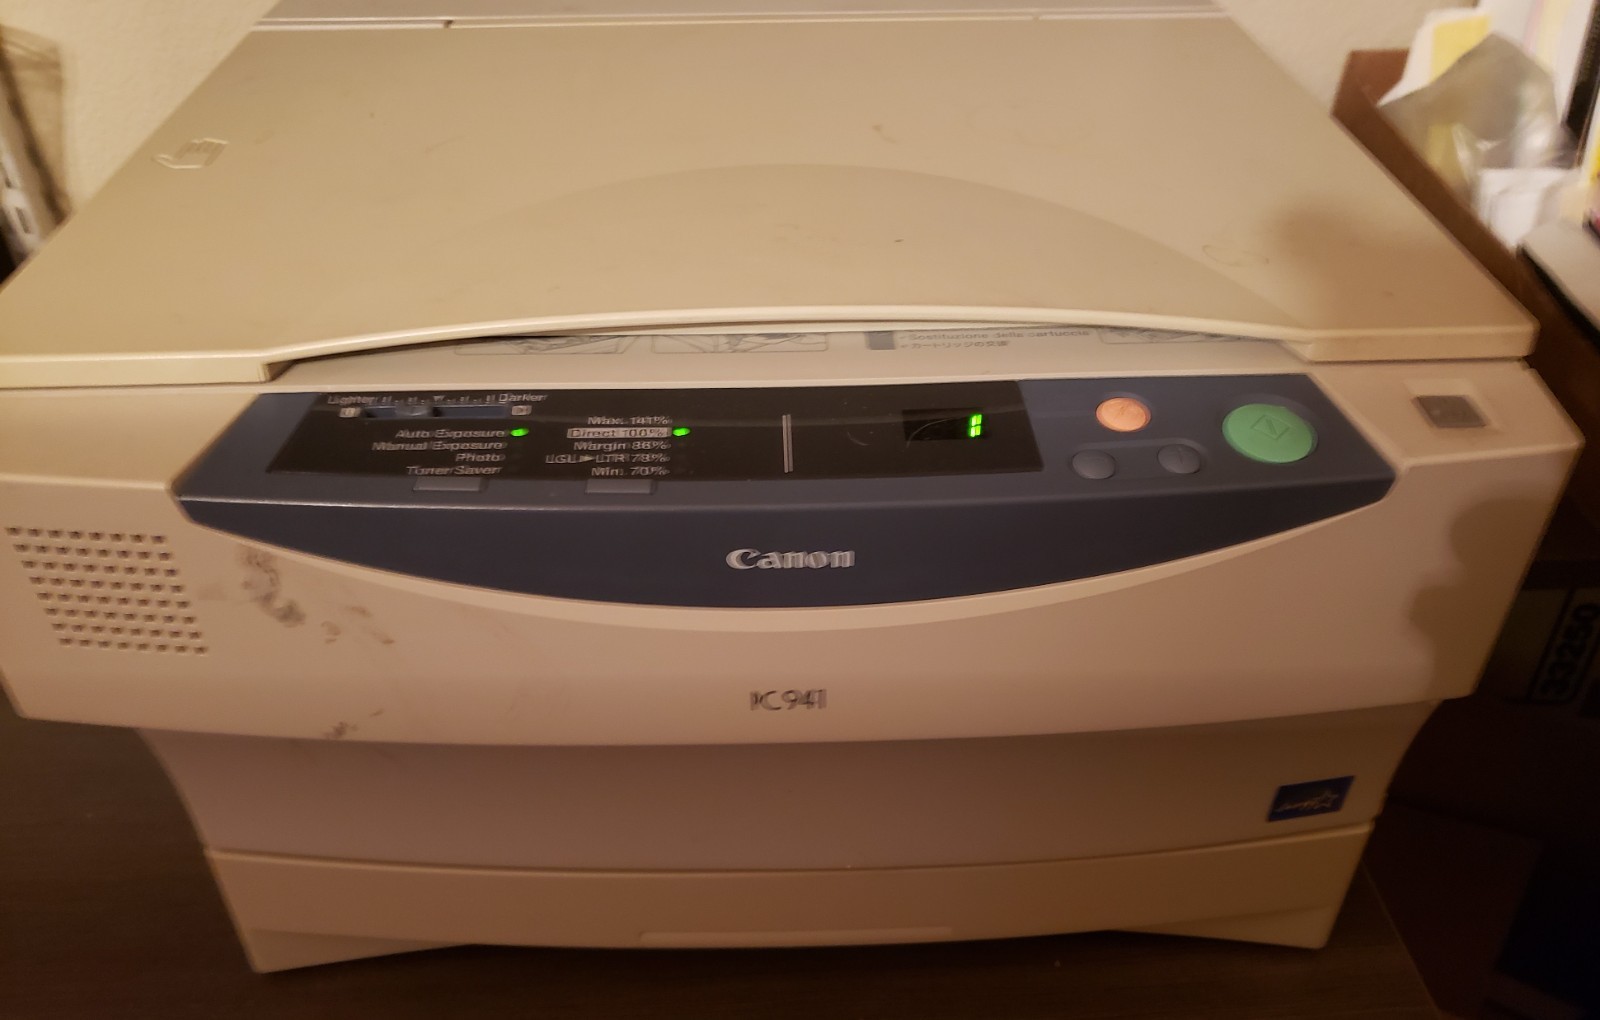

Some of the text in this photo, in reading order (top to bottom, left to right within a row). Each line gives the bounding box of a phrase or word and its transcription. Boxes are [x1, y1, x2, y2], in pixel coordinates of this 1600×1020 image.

[499, 393, 547, 403] Darker
[395, 429, 507, 441] Auto Exposure
[571, 428, 667, 438] Direct 100%
[371, 441, 506, 452] Manual Exposure
[573, 441, 626, 452] Margin
[455, 453, 505, 463] Photo
[631, 453, 670, 463] 78%
[406, 465, 501, 476] Toner Saver
[630, 466, 670, 476] 70%
[726, 548, 856, 570] Canon
